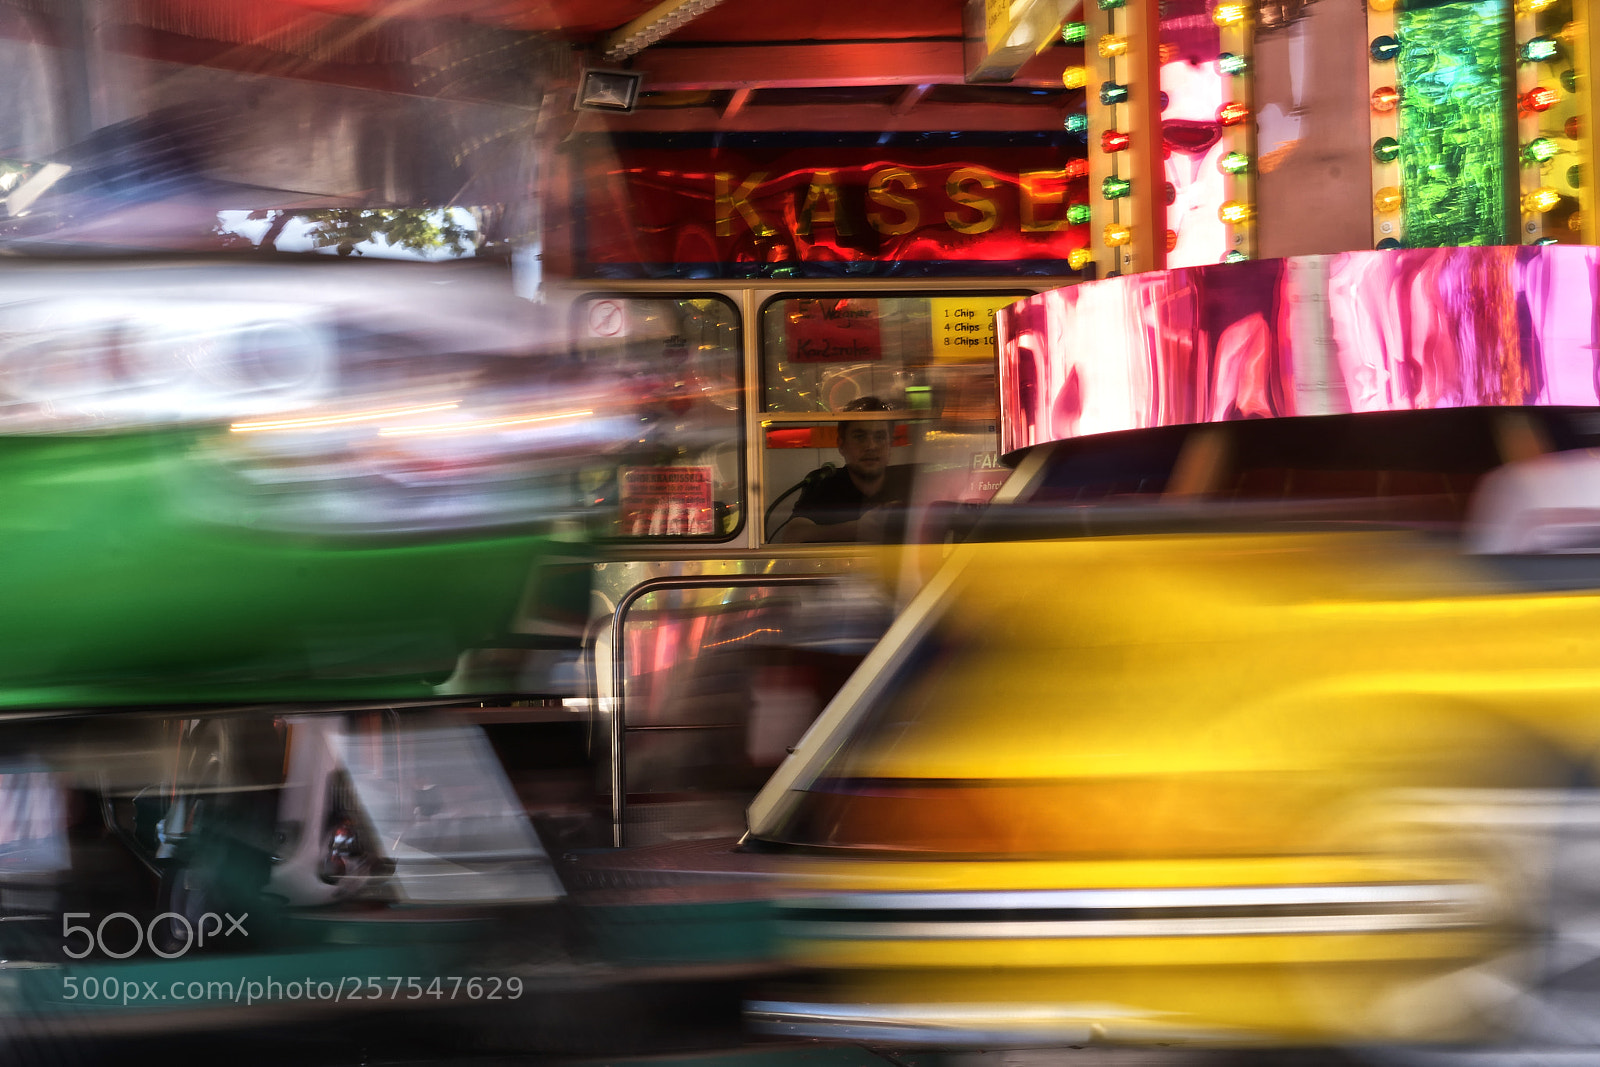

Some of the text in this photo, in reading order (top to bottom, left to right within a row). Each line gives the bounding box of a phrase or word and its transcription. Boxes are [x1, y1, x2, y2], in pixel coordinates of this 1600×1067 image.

[714, 167, 1070, 238] KASSE
[944, 309, 949, 318] 1
[953, 309, 975, 320] Chip
[943, 323, 950, 331] 4
[954, 322, 980, 333] Chips
[944, 337, 950, 345] 8
[954, 337, 980, 348] Chips
